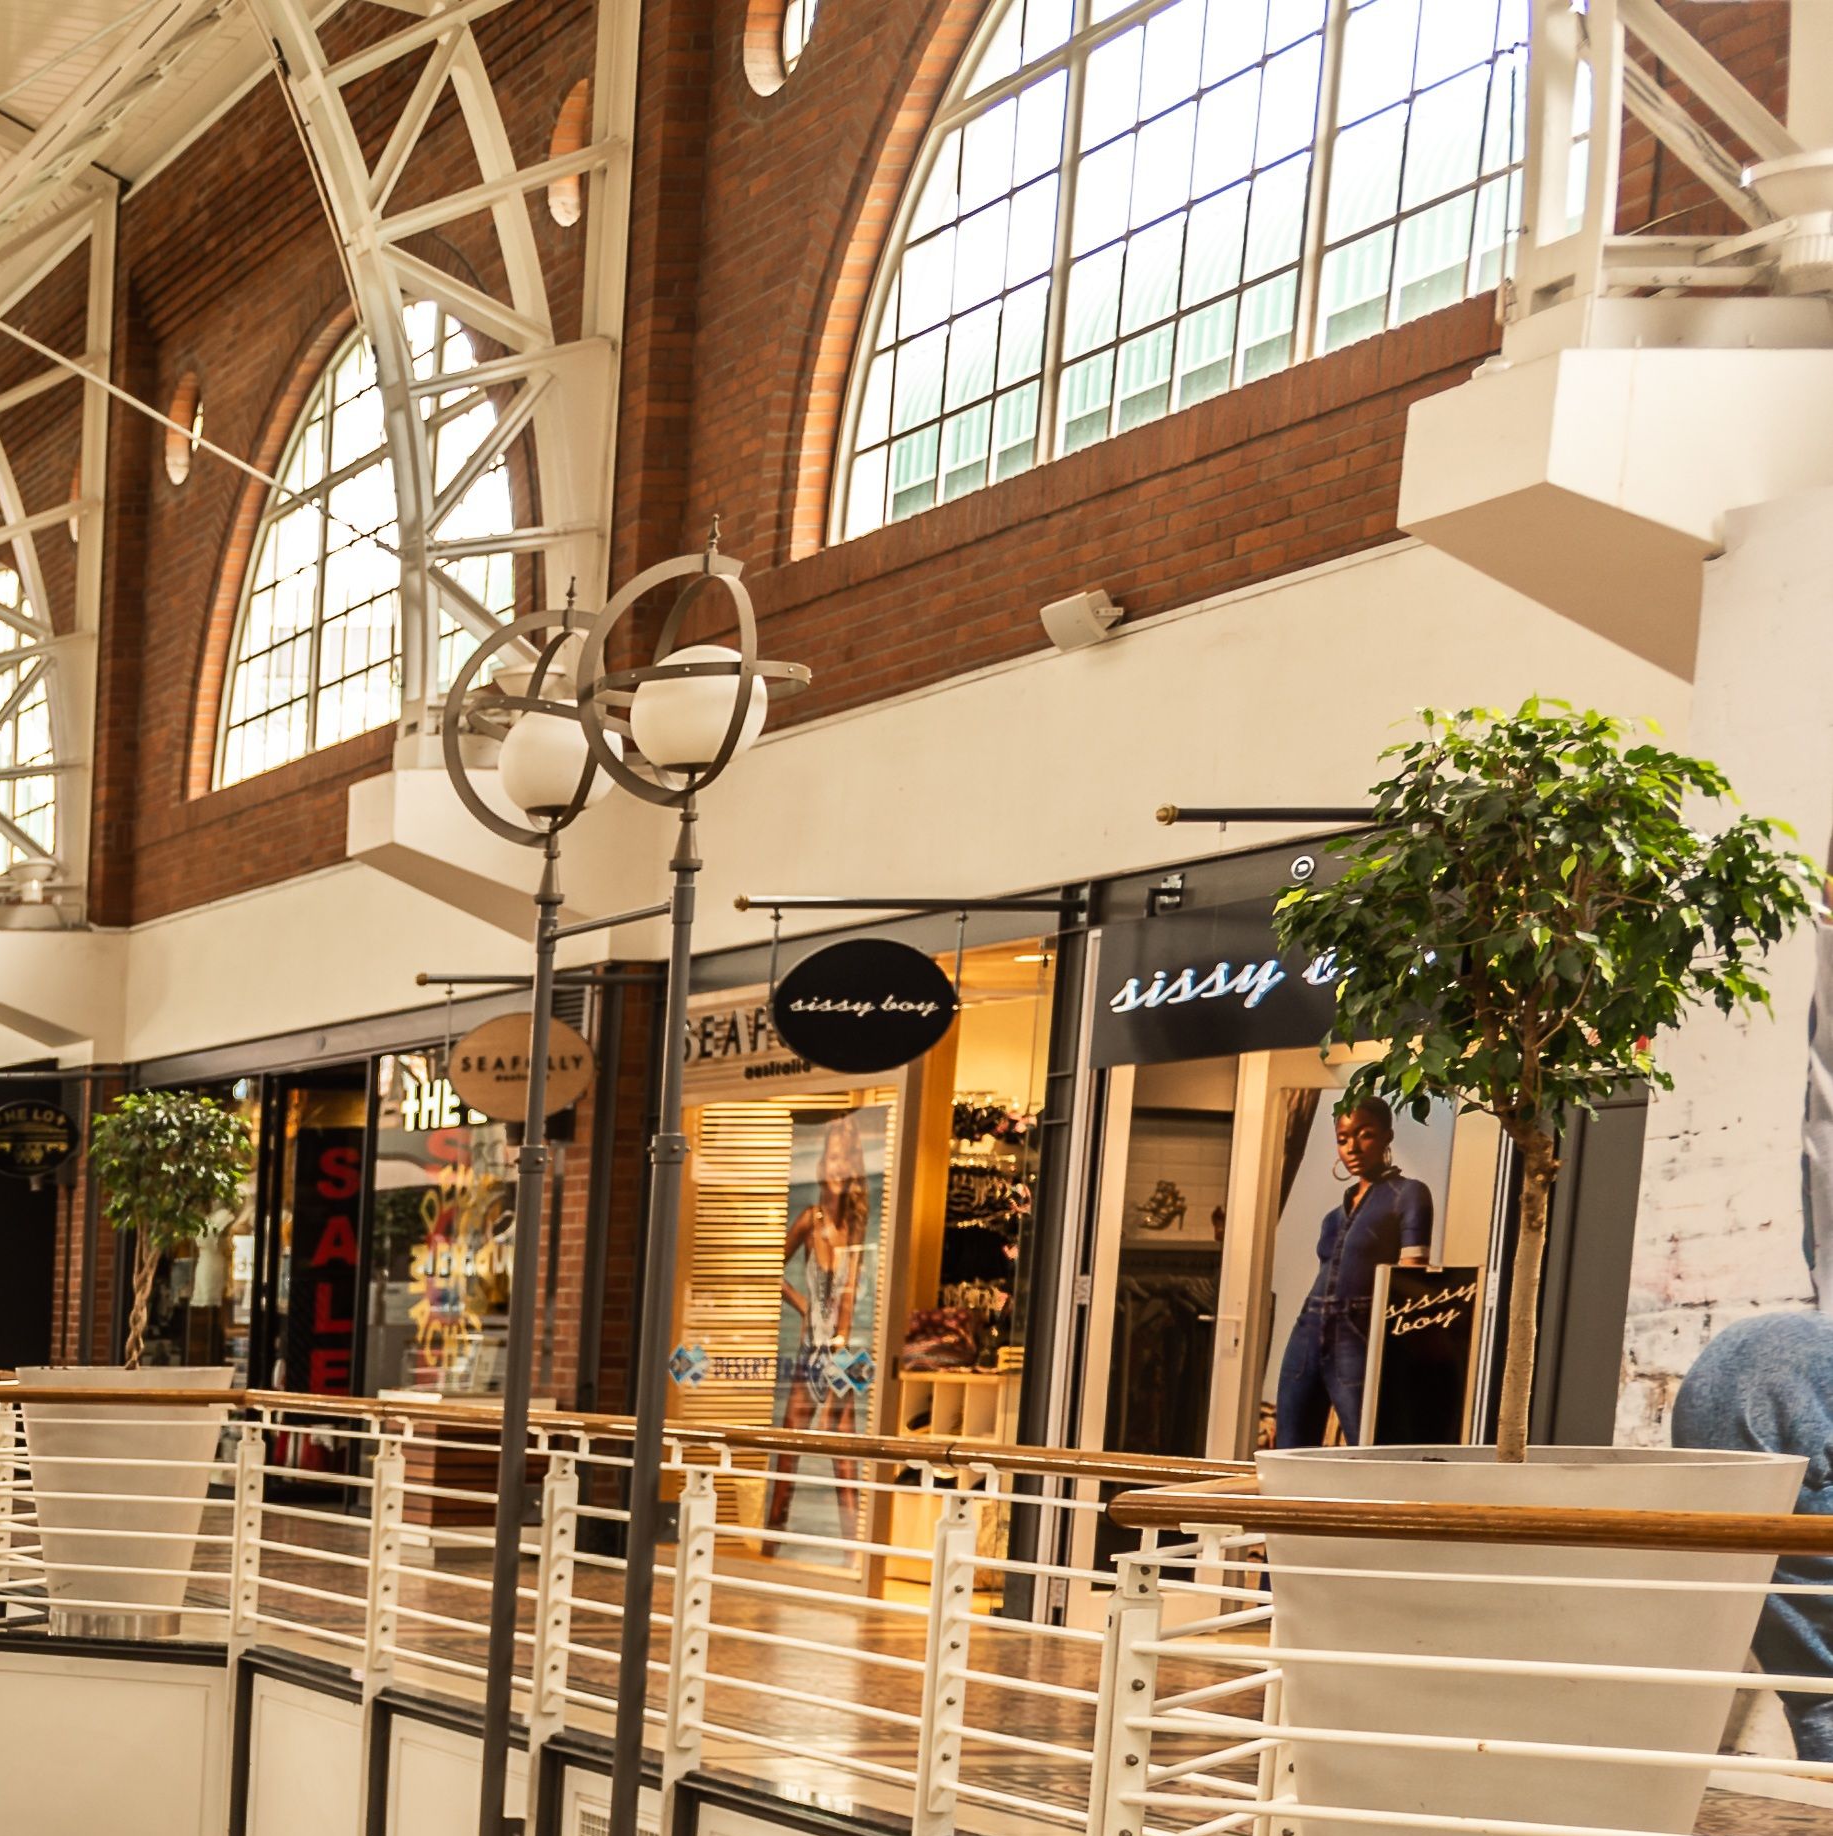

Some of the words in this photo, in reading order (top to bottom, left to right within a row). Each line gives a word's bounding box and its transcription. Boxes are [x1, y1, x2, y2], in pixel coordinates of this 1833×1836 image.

[1109, 959, 1286, 1013] sissy
[789, 996, 875, 1017] sissy
[881, 994, 940, 1017] boy
[461, 1056, 583, 1072] SEAFLLY
[1385, 1282, 1477, 1319] sissy
[1391, 1309, 1461, 1335] boy
